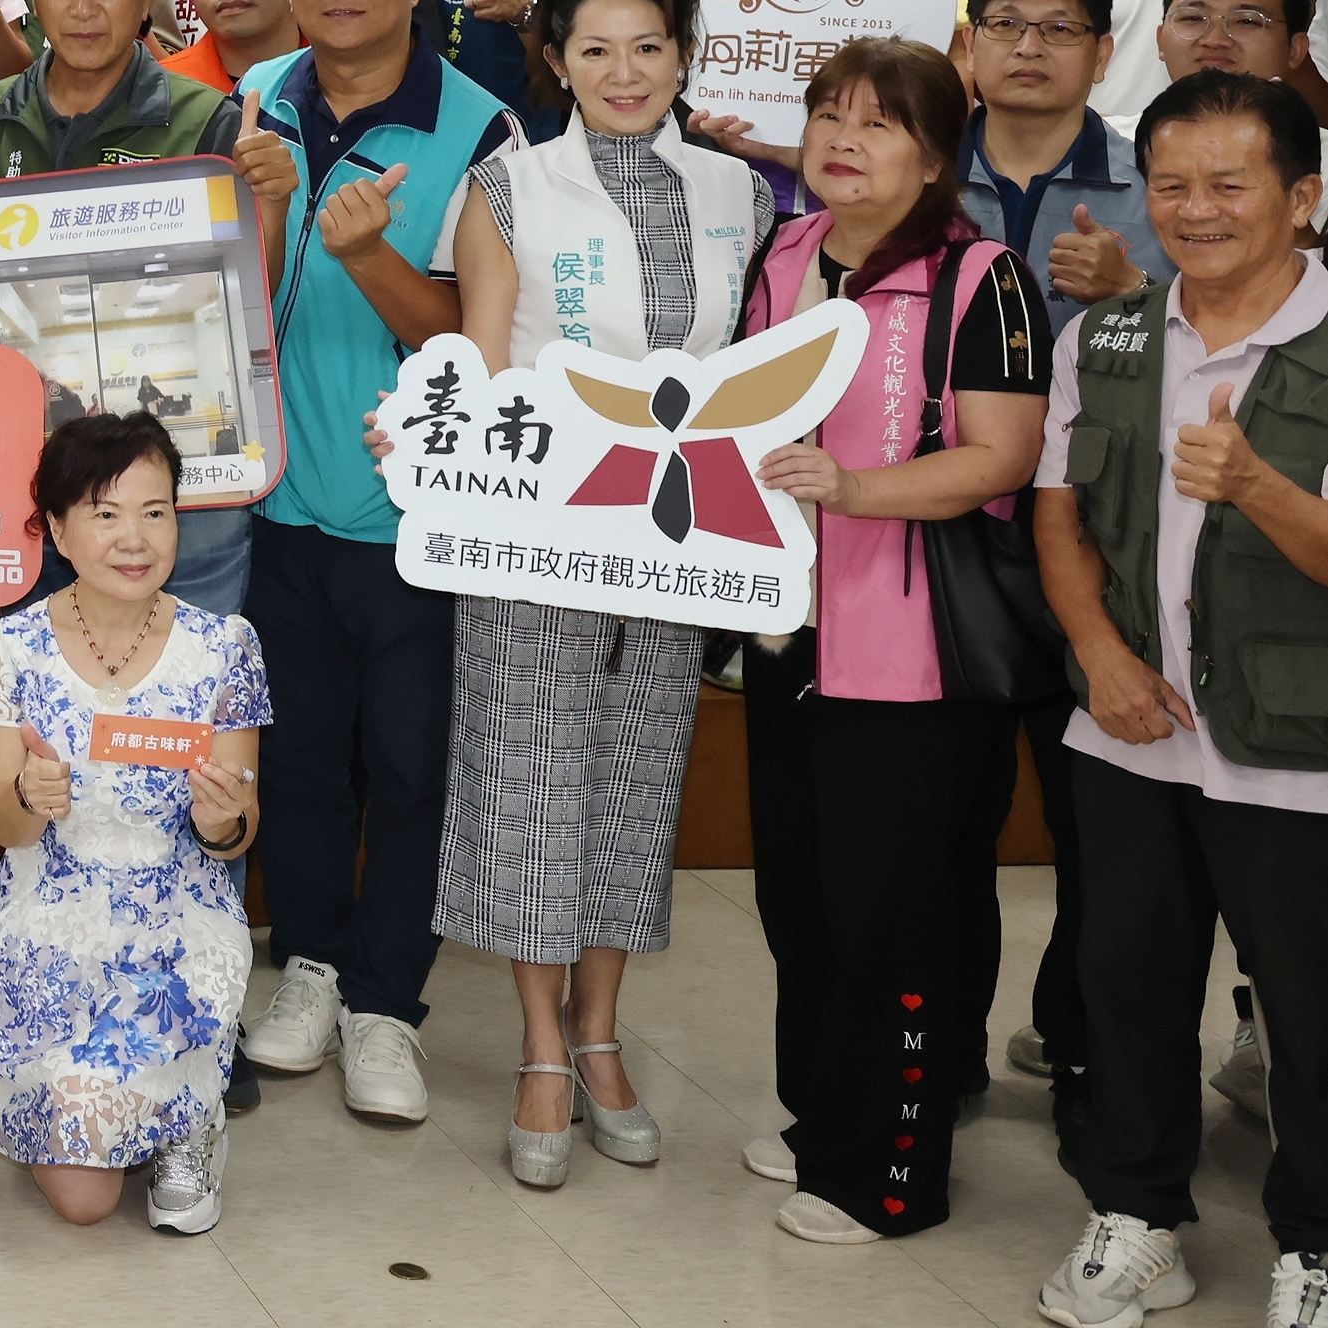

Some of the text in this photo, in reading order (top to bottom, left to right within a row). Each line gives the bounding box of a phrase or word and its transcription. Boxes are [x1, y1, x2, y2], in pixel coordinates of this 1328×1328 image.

[447, 7, 465, 63] 臺南市
[819, 16, 892, 30] SINCE 2013
[699, 29, 856, 82] 丹莉蛋
[698, 86, 724, 100] Dan
[728, 88, 744, 101] lih
[49, 196, 185, 229] 旅遊服務中心
[49, 221, 185, 241] Visitor Information Center
[587, 237, 606, 286] 理事長
[552, 252, 592, 349] 侯翠玲
[881, 293, 910, 464] 府城文化觀光產業
[402, 361, 554, 465] 臺南
[180, 463, 245, 487] 務中心
[410, 465, 538, 502] TAINAN
[423, 531, 782, 609] 臺南市政府觀光旅遊局
[110, 731, 192, 754] 府都古味軒
[903, 1031, 926, 1050] M
[900, 1103, 921, 1120] M
[888, 1165, 911, 1183] M
